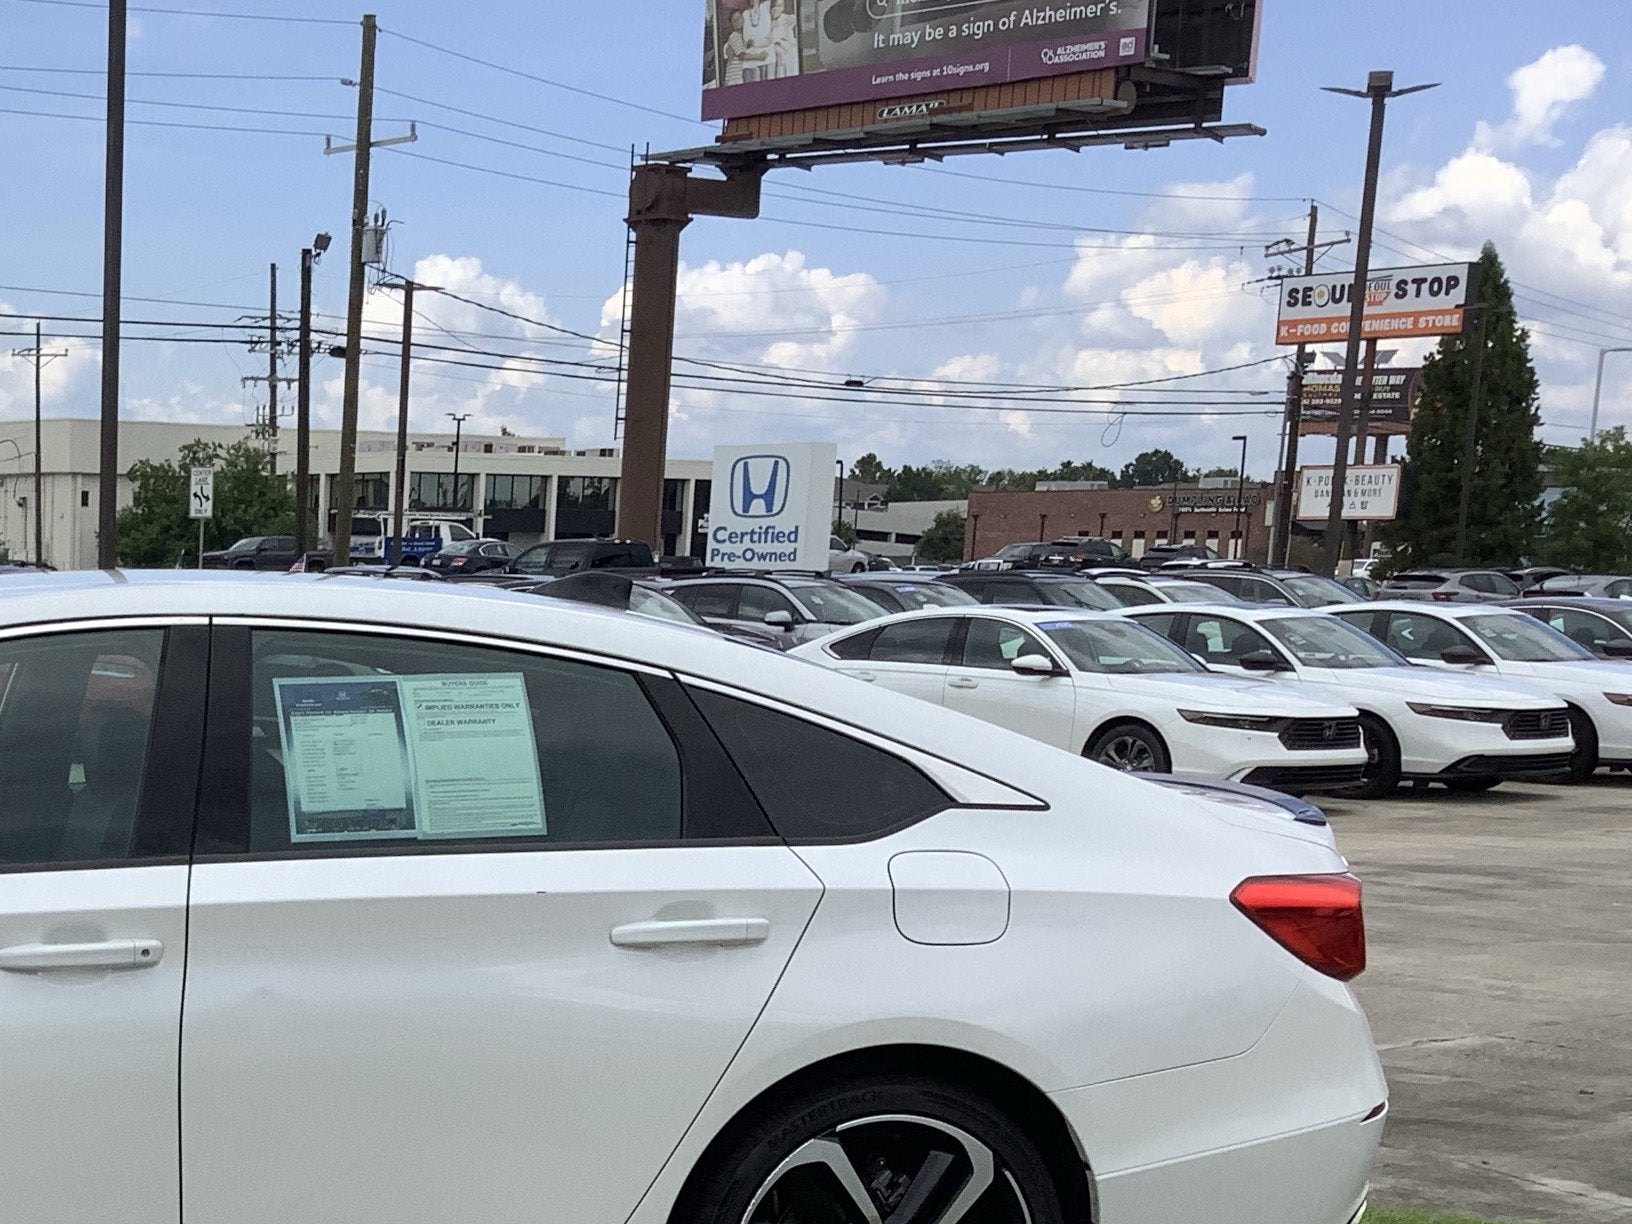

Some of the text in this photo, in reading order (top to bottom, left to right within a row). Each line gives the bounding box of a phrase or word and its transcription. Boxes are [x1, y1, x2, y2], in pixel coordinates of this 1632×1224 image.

[873, 0, 1123, 48] It may be a sign of Alzheimer's.
[1056, 41, 1106, 55] ALZHEIMER'S
[1053, 49, 1106, 64] ASSOCIATION
[871, 61, 990, 85] Learn the signs at 10signs.org
[1394, 275, 1460, 300] STOP
[1279, 314, 1460, 338] K-FOOD COENIENCE STORE
[1306, 475, 1333, 486] K-PO
[712, 525, 799, 544] Certified
[710, 547, 797, 563] Pre-Owned
[425, 703, 453, 711] IMPLIED
[453, 702, 500, 711] WARRANTIES
[426, 718, 497, 727] DEALER WARRANTY
